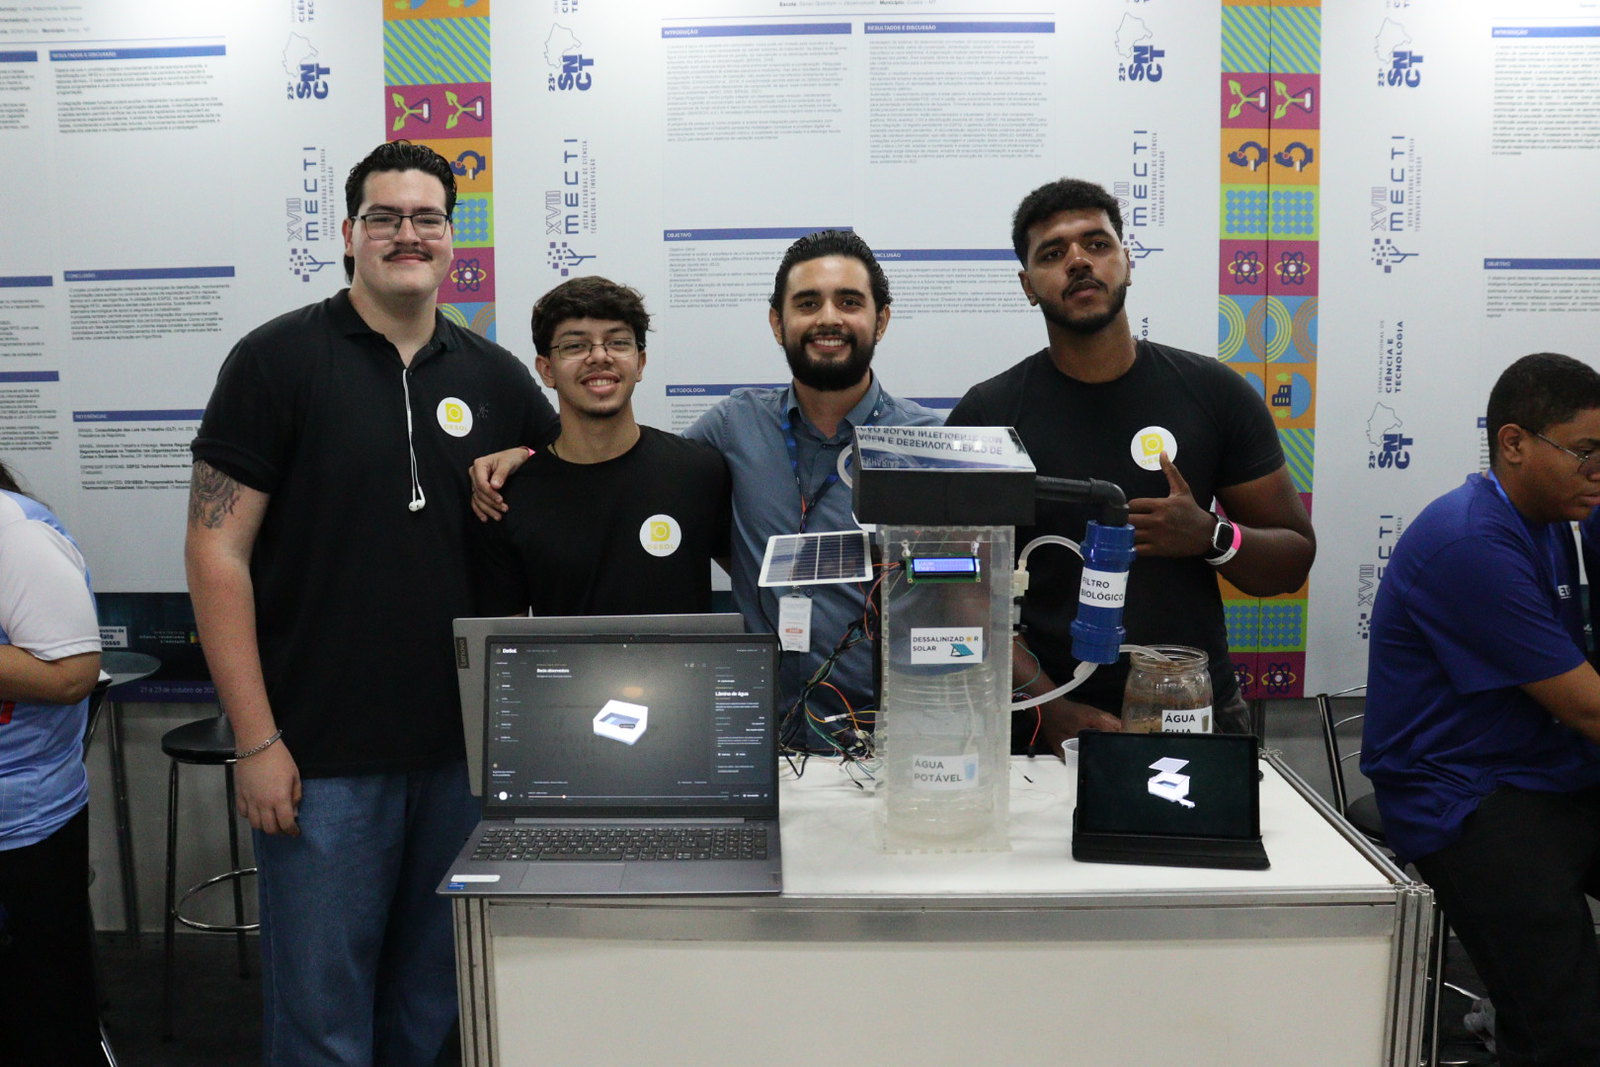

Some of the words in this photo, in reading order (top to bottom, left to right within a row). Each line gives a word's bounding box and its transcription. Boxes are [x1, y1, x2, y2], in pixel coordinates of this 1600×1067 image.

[302, 146, 319, 241] MECTI
[563, 139, 579, 235] MECTI
[1133, 130, 1148, 227] MECTI
[1390, 136, 1405, 231] MECTI
[286, 198, 302, 242] XVIII
[546, 191, 561, 235] XVIII
[1371, 186, 1386, 231] XVIII
[1385, 349, 1393, 393] CIÊNCIA
[1358, 564, 1374, 606] XVIII
[1164, 712, 1196, 723] ÁGUA
[914, 758, 944, 769] ÁGUA
[914, 773, 962, 782] POTÁVEL
